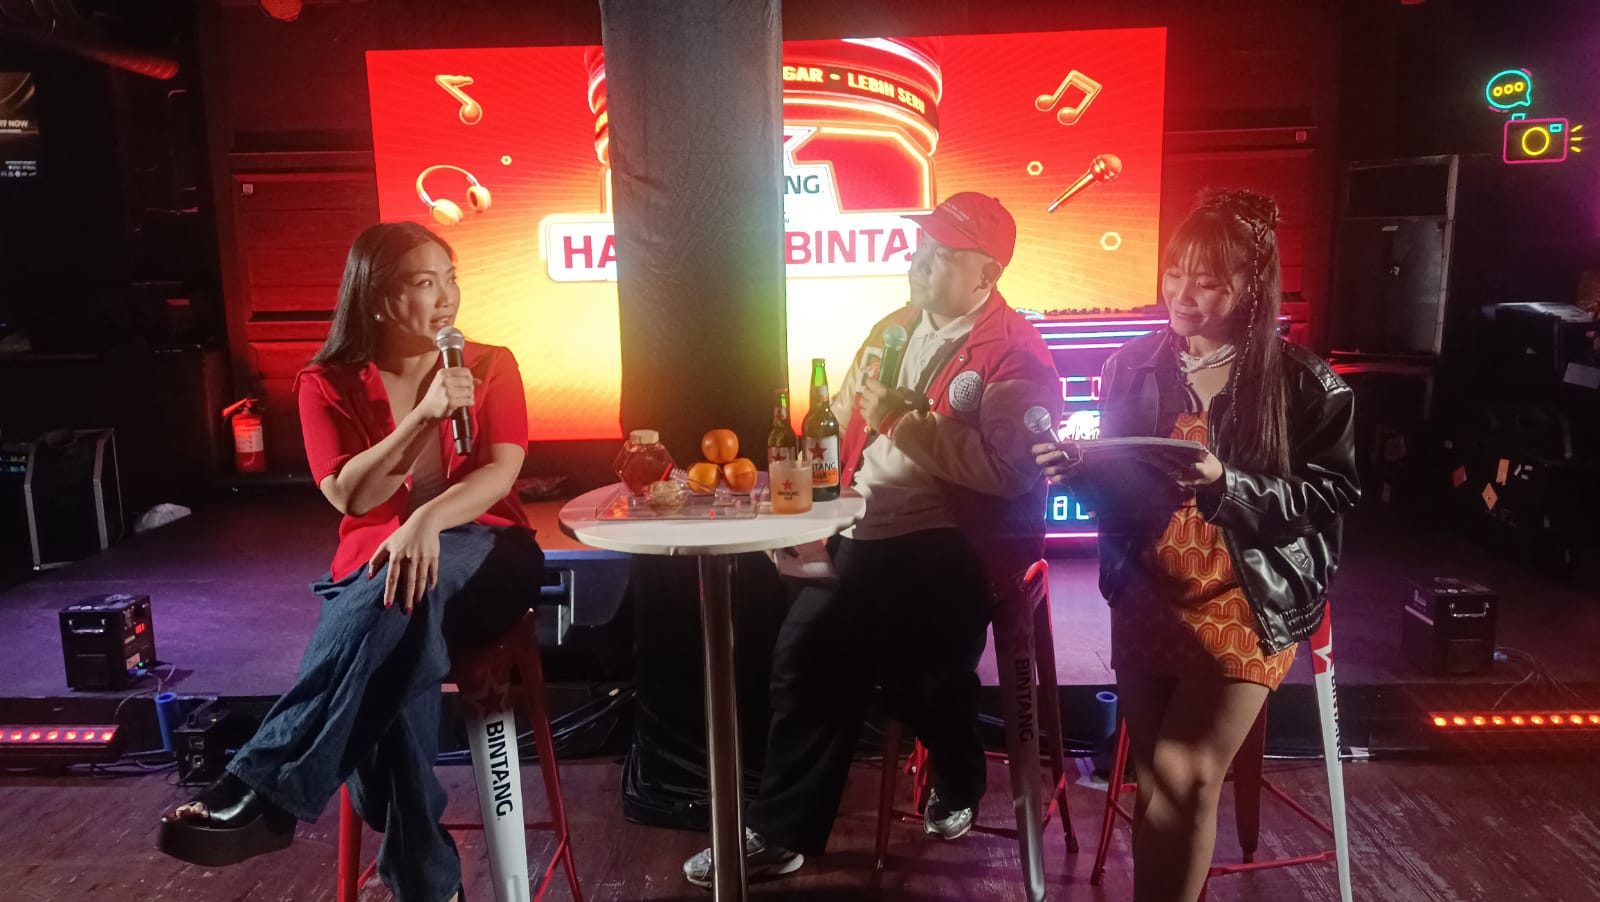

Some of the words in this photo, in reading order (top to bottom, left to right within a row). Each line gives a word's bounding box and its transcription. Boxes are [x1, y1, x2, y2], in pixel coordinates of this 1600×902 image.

[782, 65, 824, 83] GAR
[847, 72, 895, 98] LEBIH
[897, 87, 926, 115] SERU
[784, 175, 820, 195] NG
[563, 234, 617, 270] HA
[785, 228, 922, 265] BINTA
[1015, 658, 1034, 744] BINTANG
[486, 719, 514, 817] BINTANG
